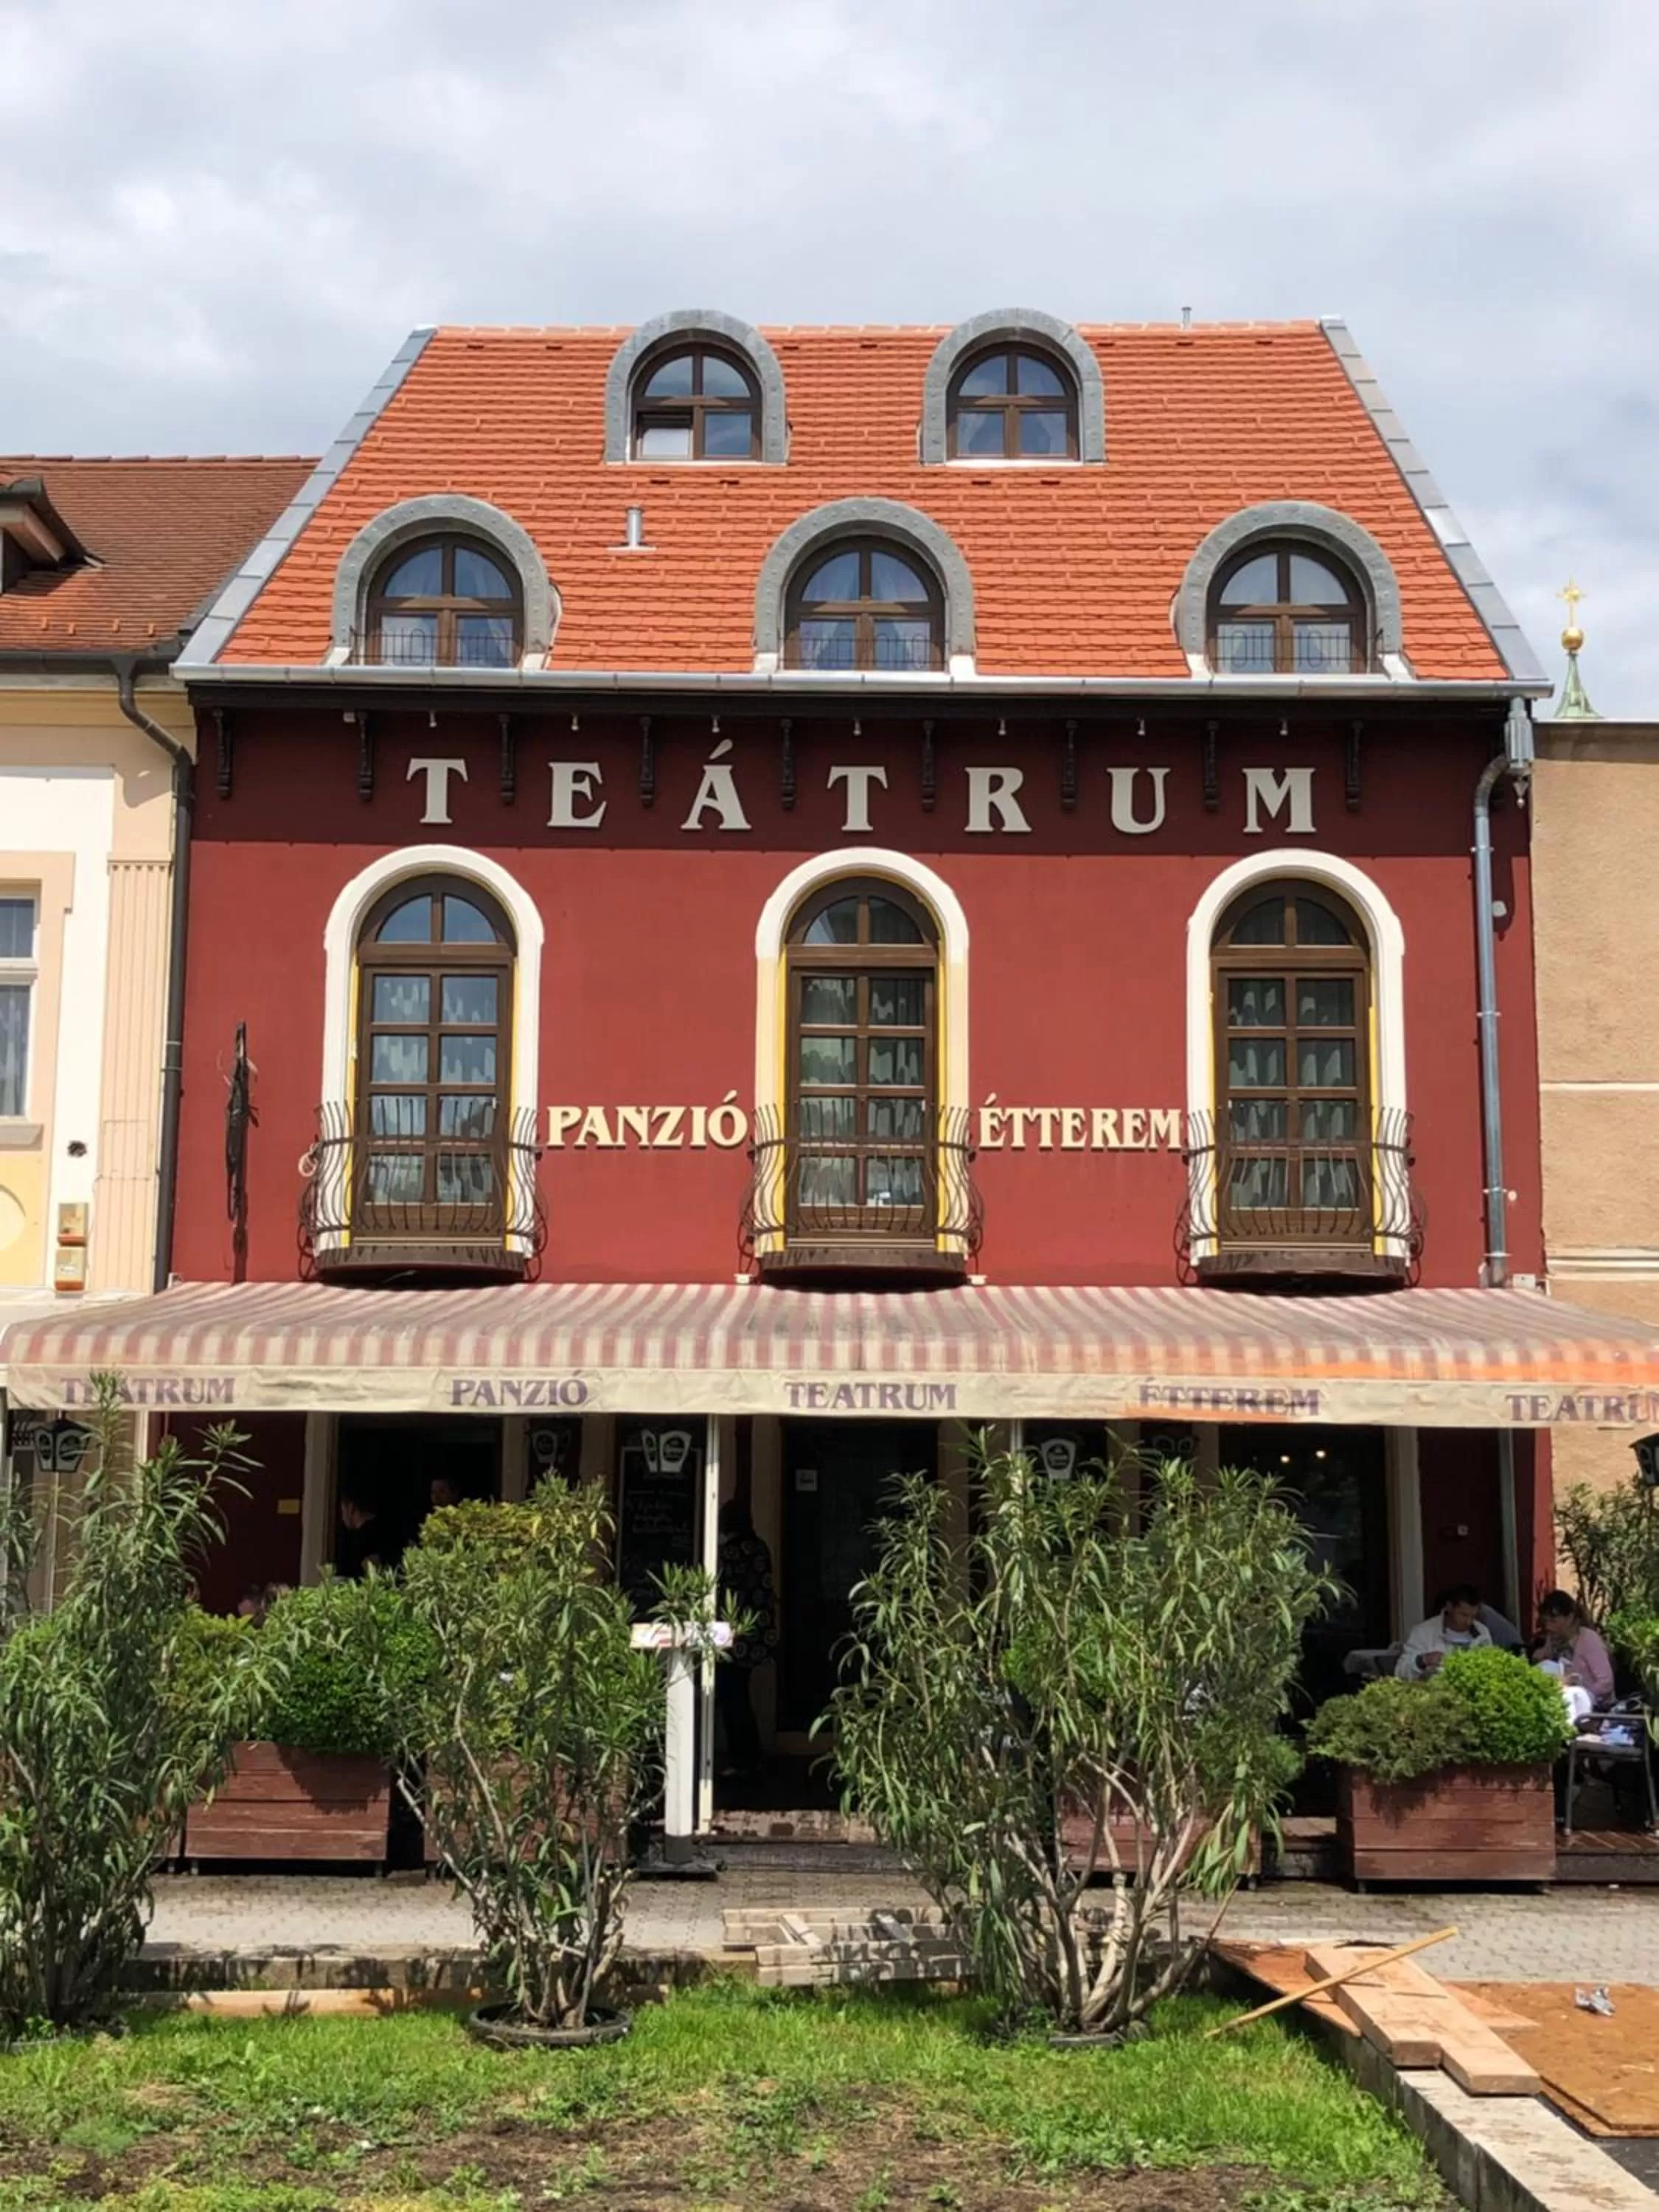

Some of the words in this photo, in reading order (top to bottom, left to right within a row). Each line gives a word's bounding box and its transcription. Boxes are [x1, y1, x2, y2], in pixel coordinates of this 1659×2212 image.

[406, 739, 1317, 834] TEÁTRUM
[546, 1090, 748, 1147] PANZIÓ
[978, 1093, 1182, 1148] ÉTTEREM
[450, 1369, 588, 1406] PANZIÓ
[784, 1382, 957, 1411] TEATRUM
[1138, 1377, 1321, 1416] ÉTTEREM
